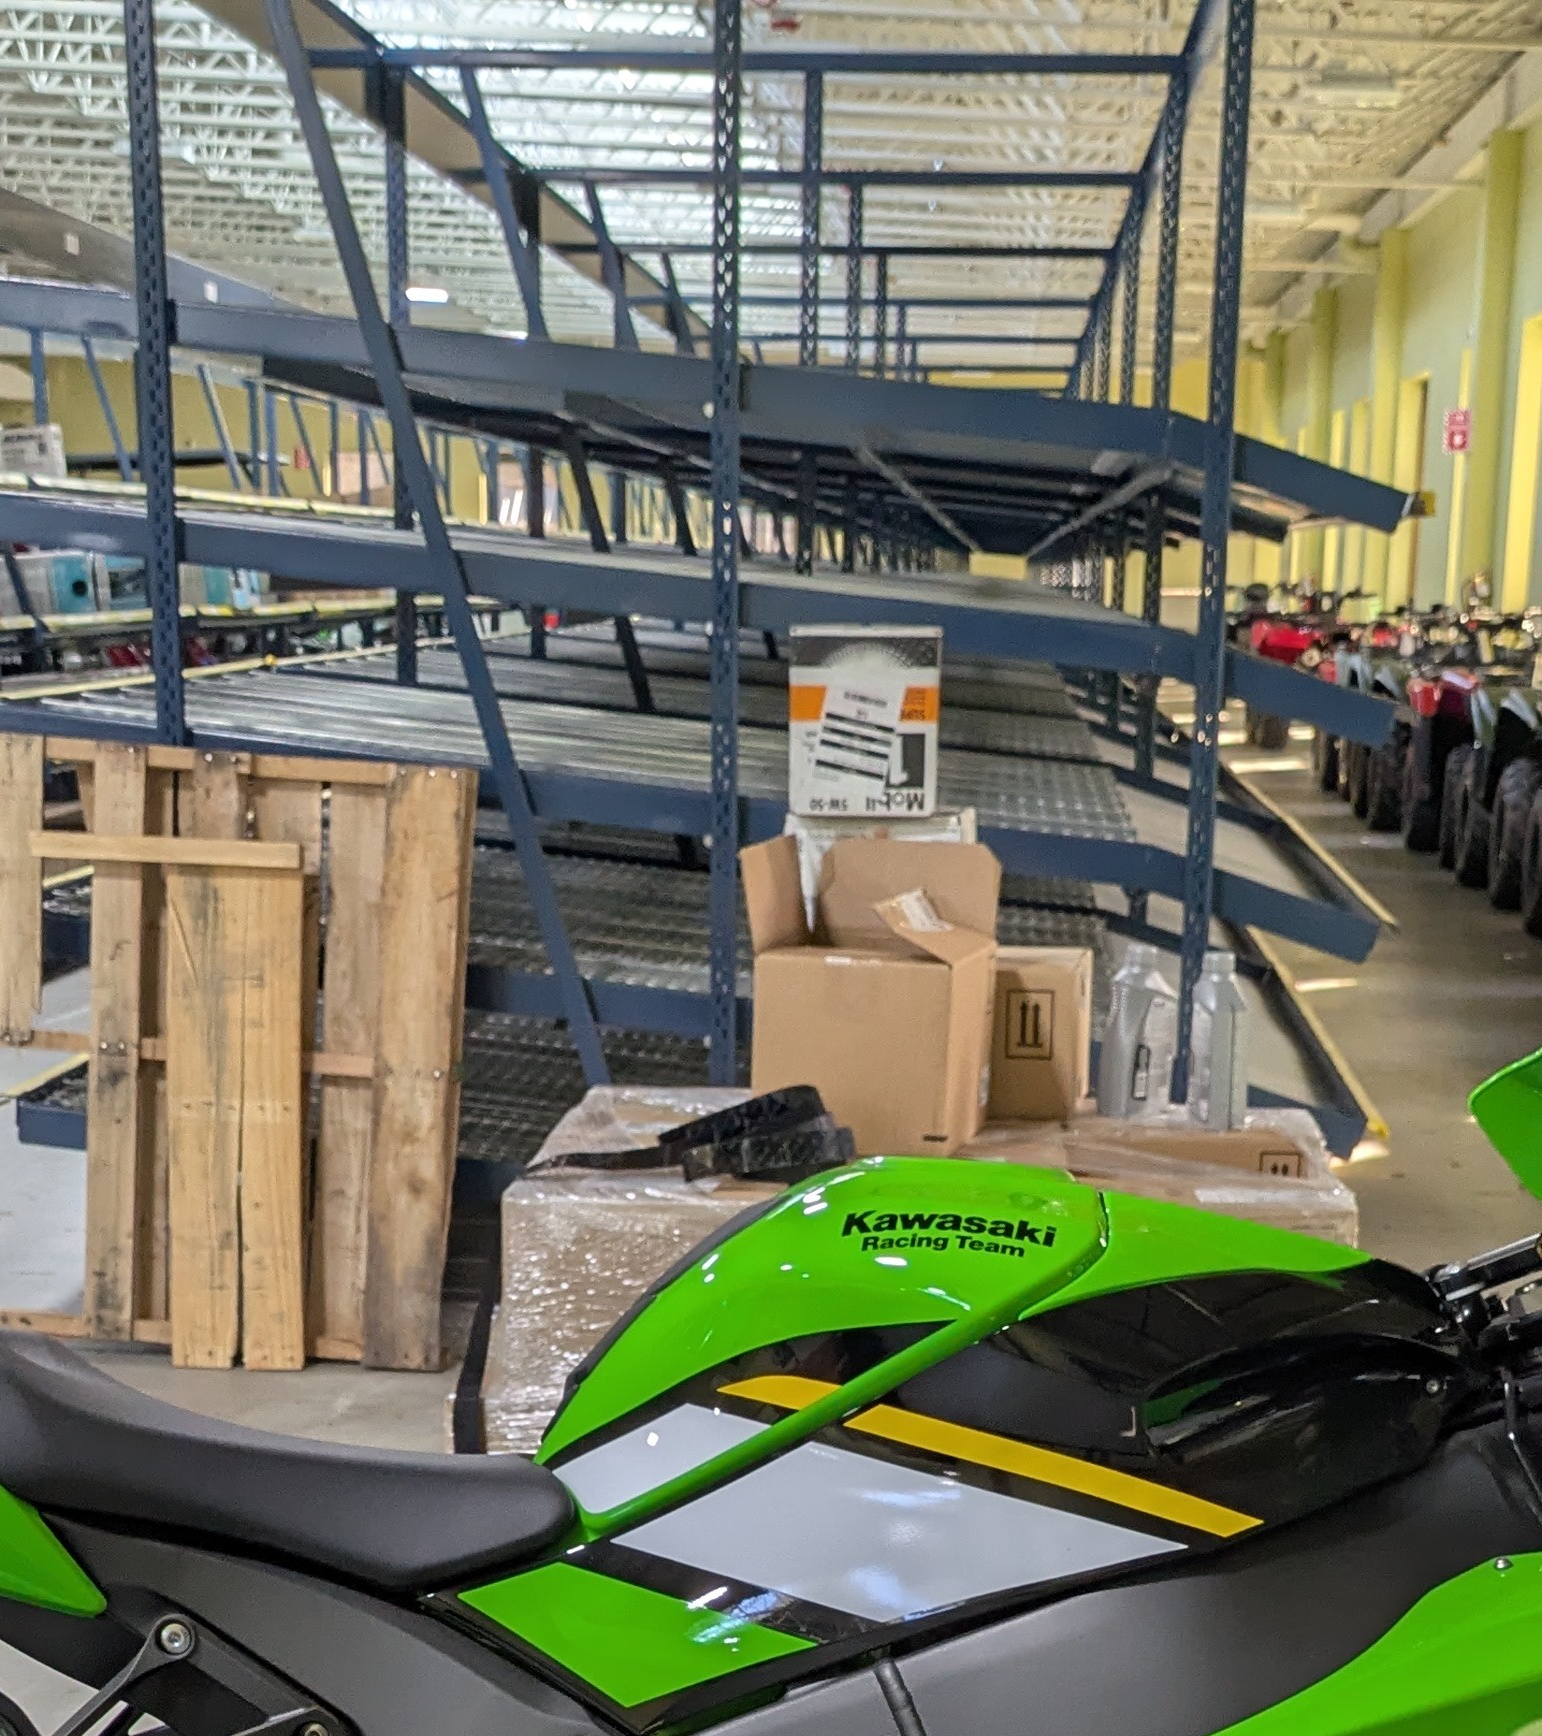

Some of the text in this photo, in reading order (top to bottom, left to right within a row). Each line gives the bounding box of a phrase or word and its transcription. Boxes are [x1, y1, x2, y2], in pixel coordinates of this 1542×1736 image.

[840, 1210, 1058, 1247] Kawasaki
[861, 1233, 1026, 1257] Racing Team
